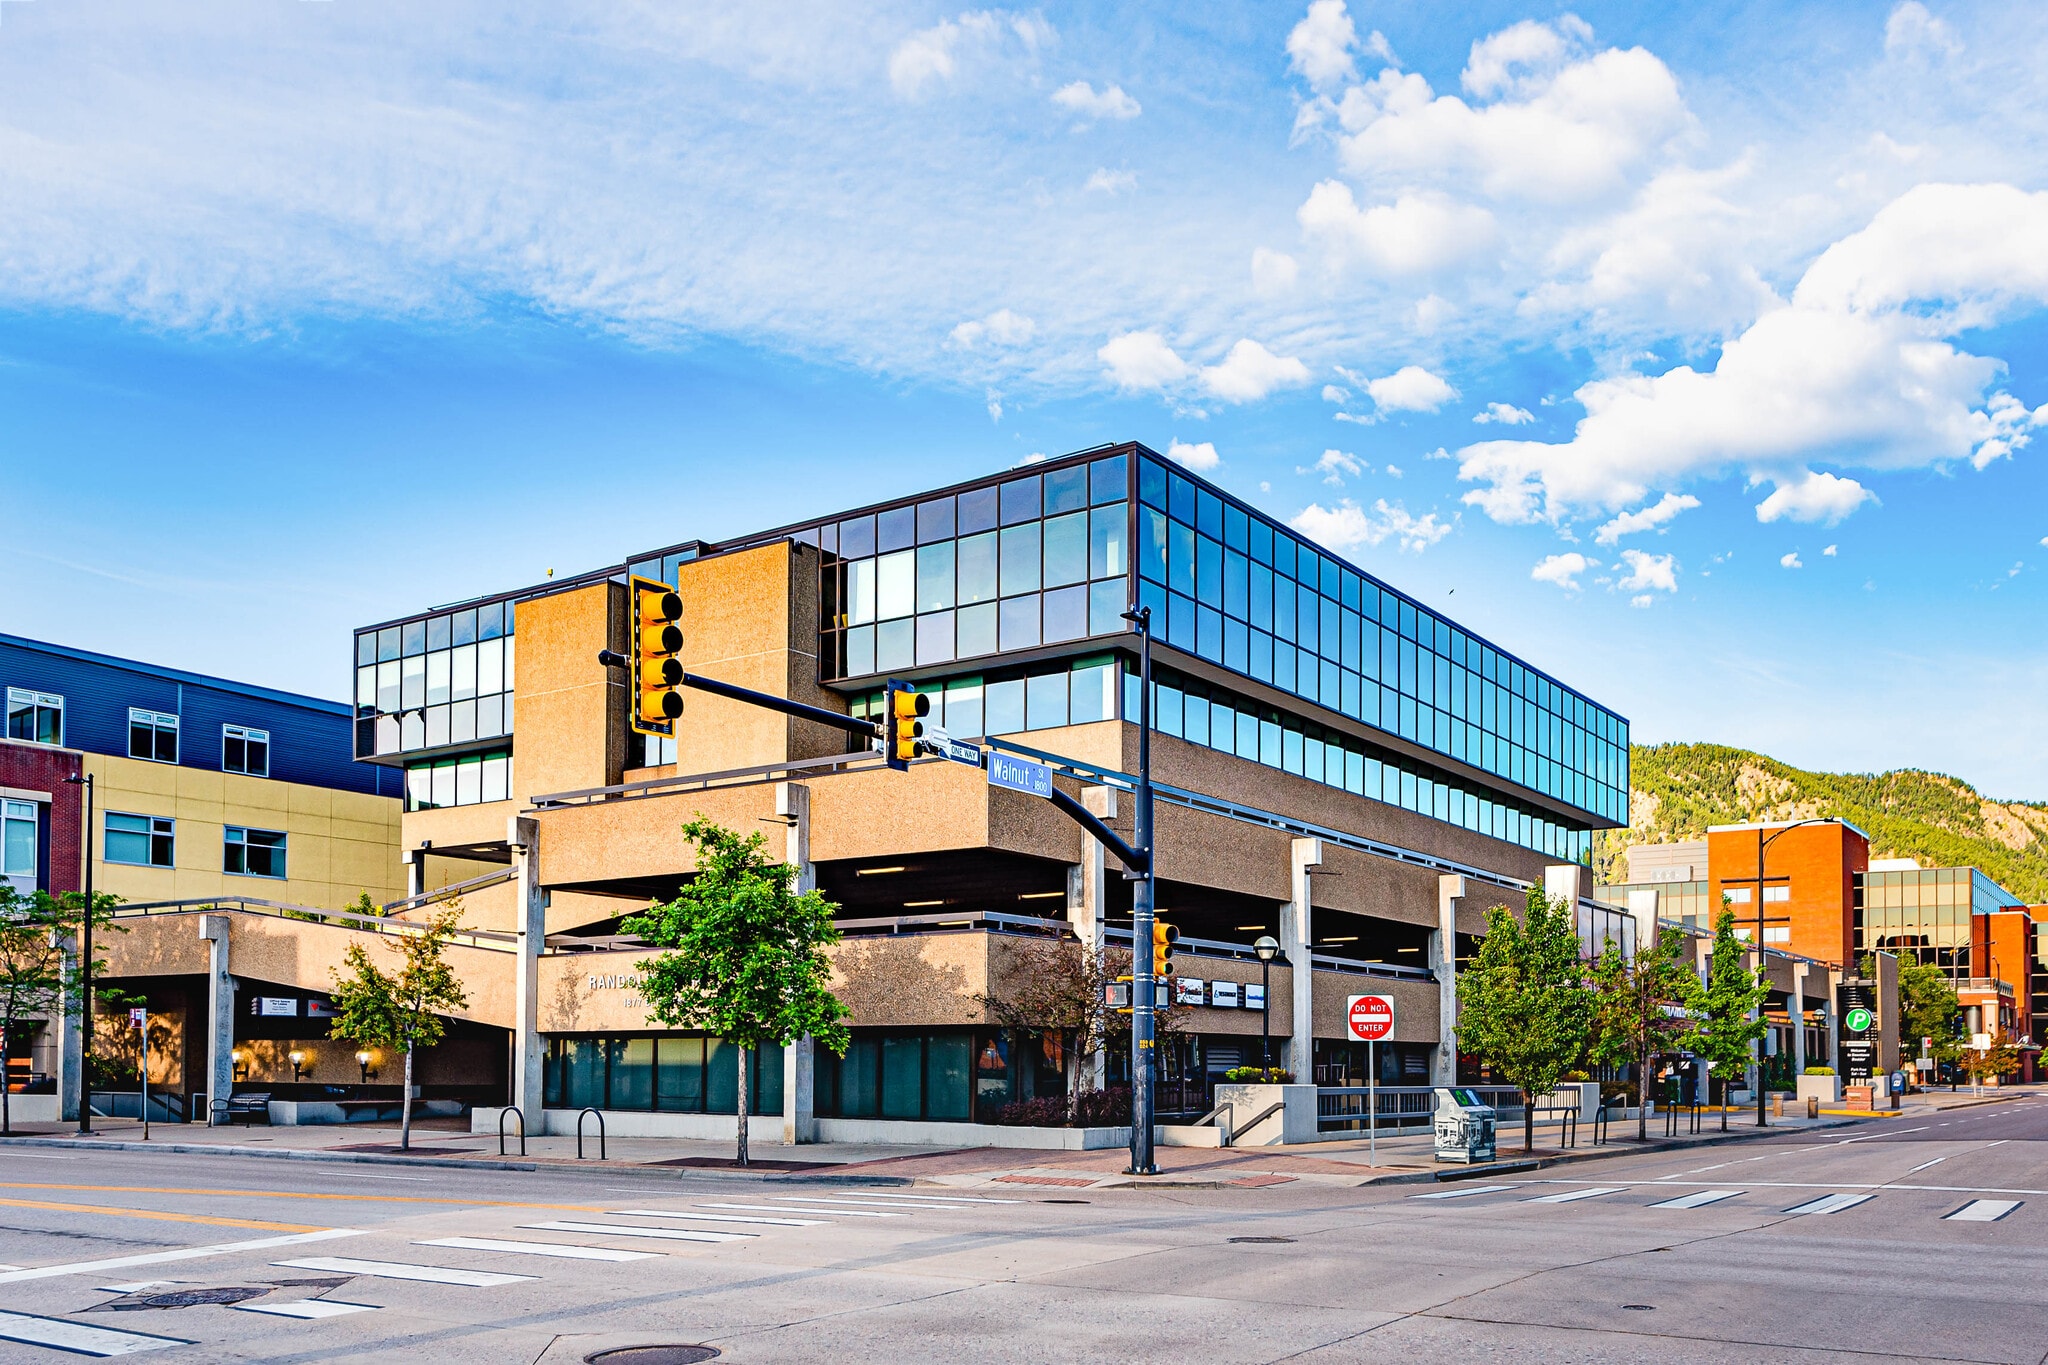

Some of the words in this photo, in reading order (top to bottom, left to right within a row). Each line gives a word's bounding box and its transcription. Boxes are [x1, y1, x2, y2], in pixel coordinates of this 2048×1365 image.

[951, 745, 963, 757] ONE
[964, 750, 977, 760] WAY
[993, 757, 1029, 786] Walnut
[1038, 768, 1044, 779] St
[1355, 1004, 1366, 1012] DO
[1370, 1004, 1386, 1012] NOT
[1852, 1012, 1867, 1028] P
